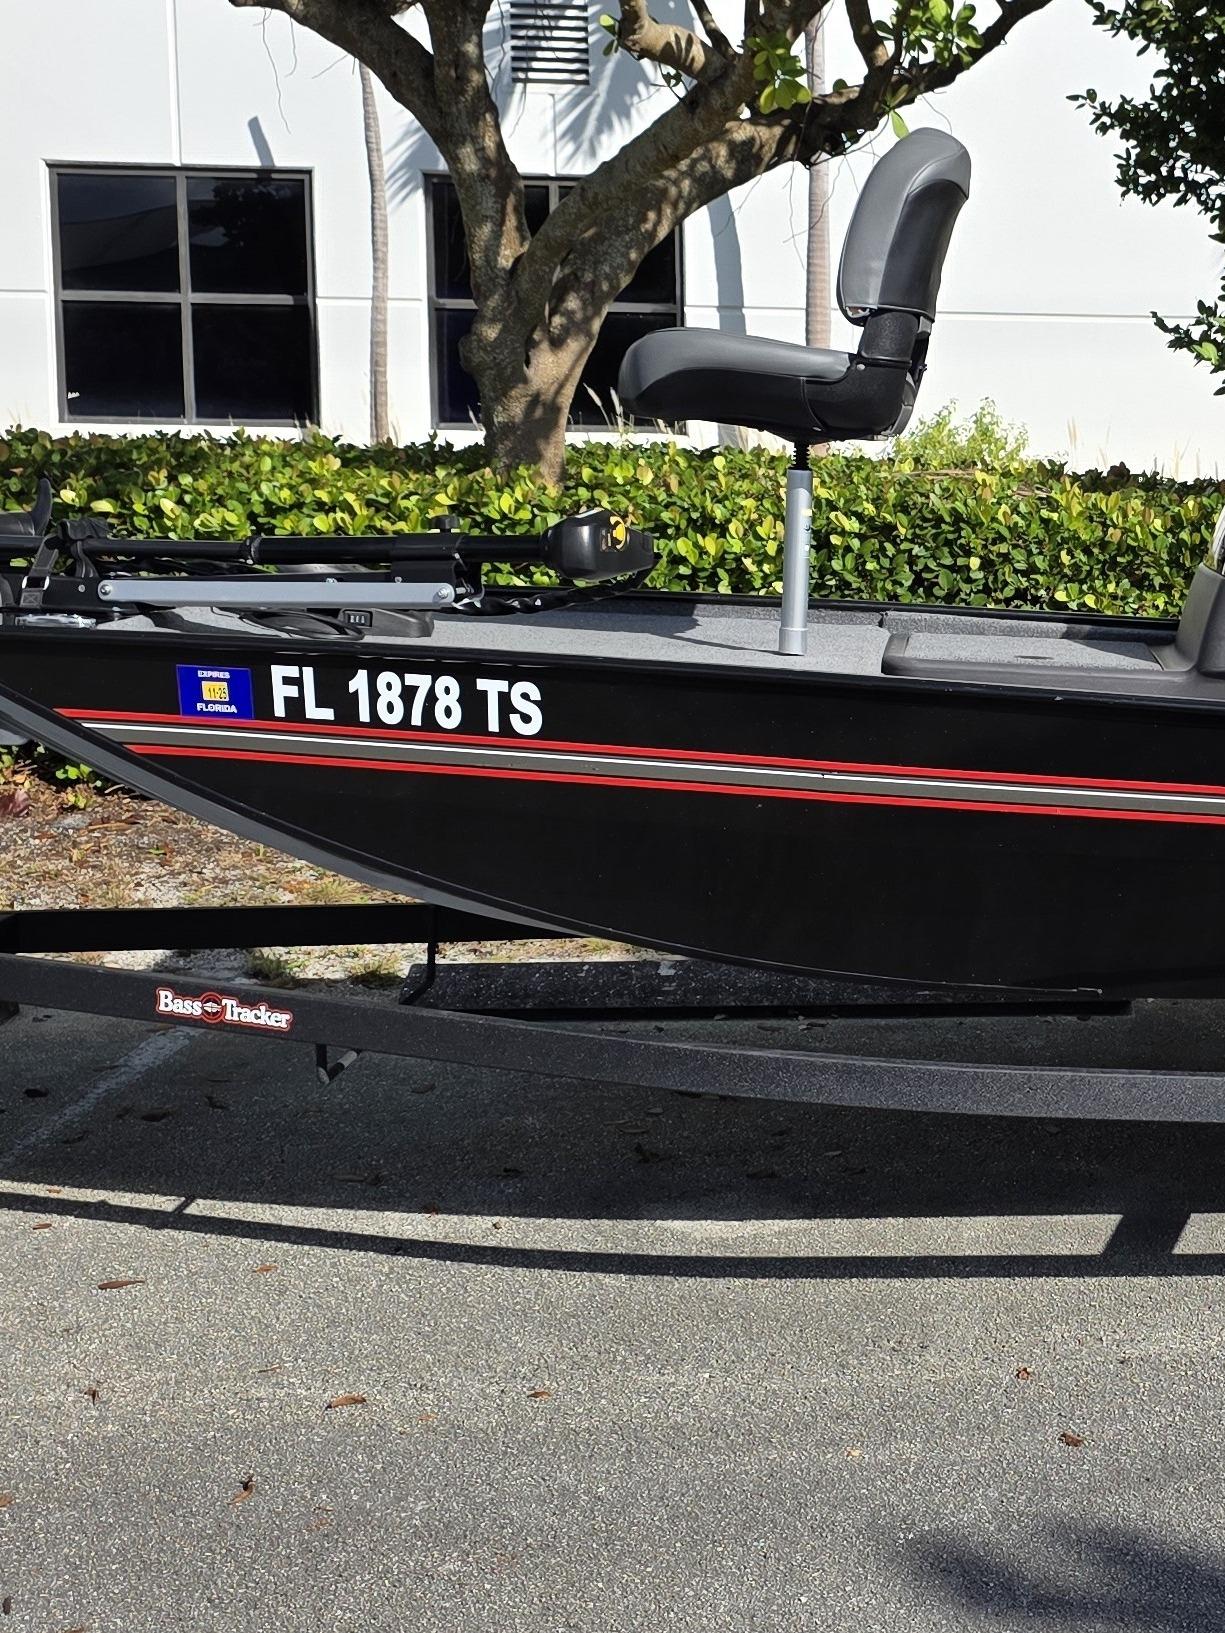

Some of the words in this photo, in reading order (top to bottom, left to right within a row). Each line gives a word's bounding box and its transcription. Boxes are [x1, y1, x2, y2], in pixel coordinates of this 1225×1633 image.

[197, 670, 230, 679] EXPIRES
[196, 702, 238, 714] FLORIDA
[270, 664, 335, 721] FL
[348, 669, 462, 730] 1878
[476, 678, 543, 736] TS
[158, 990, 203, 1016] Bass
[221, 999, 291, 1028] Tracker
